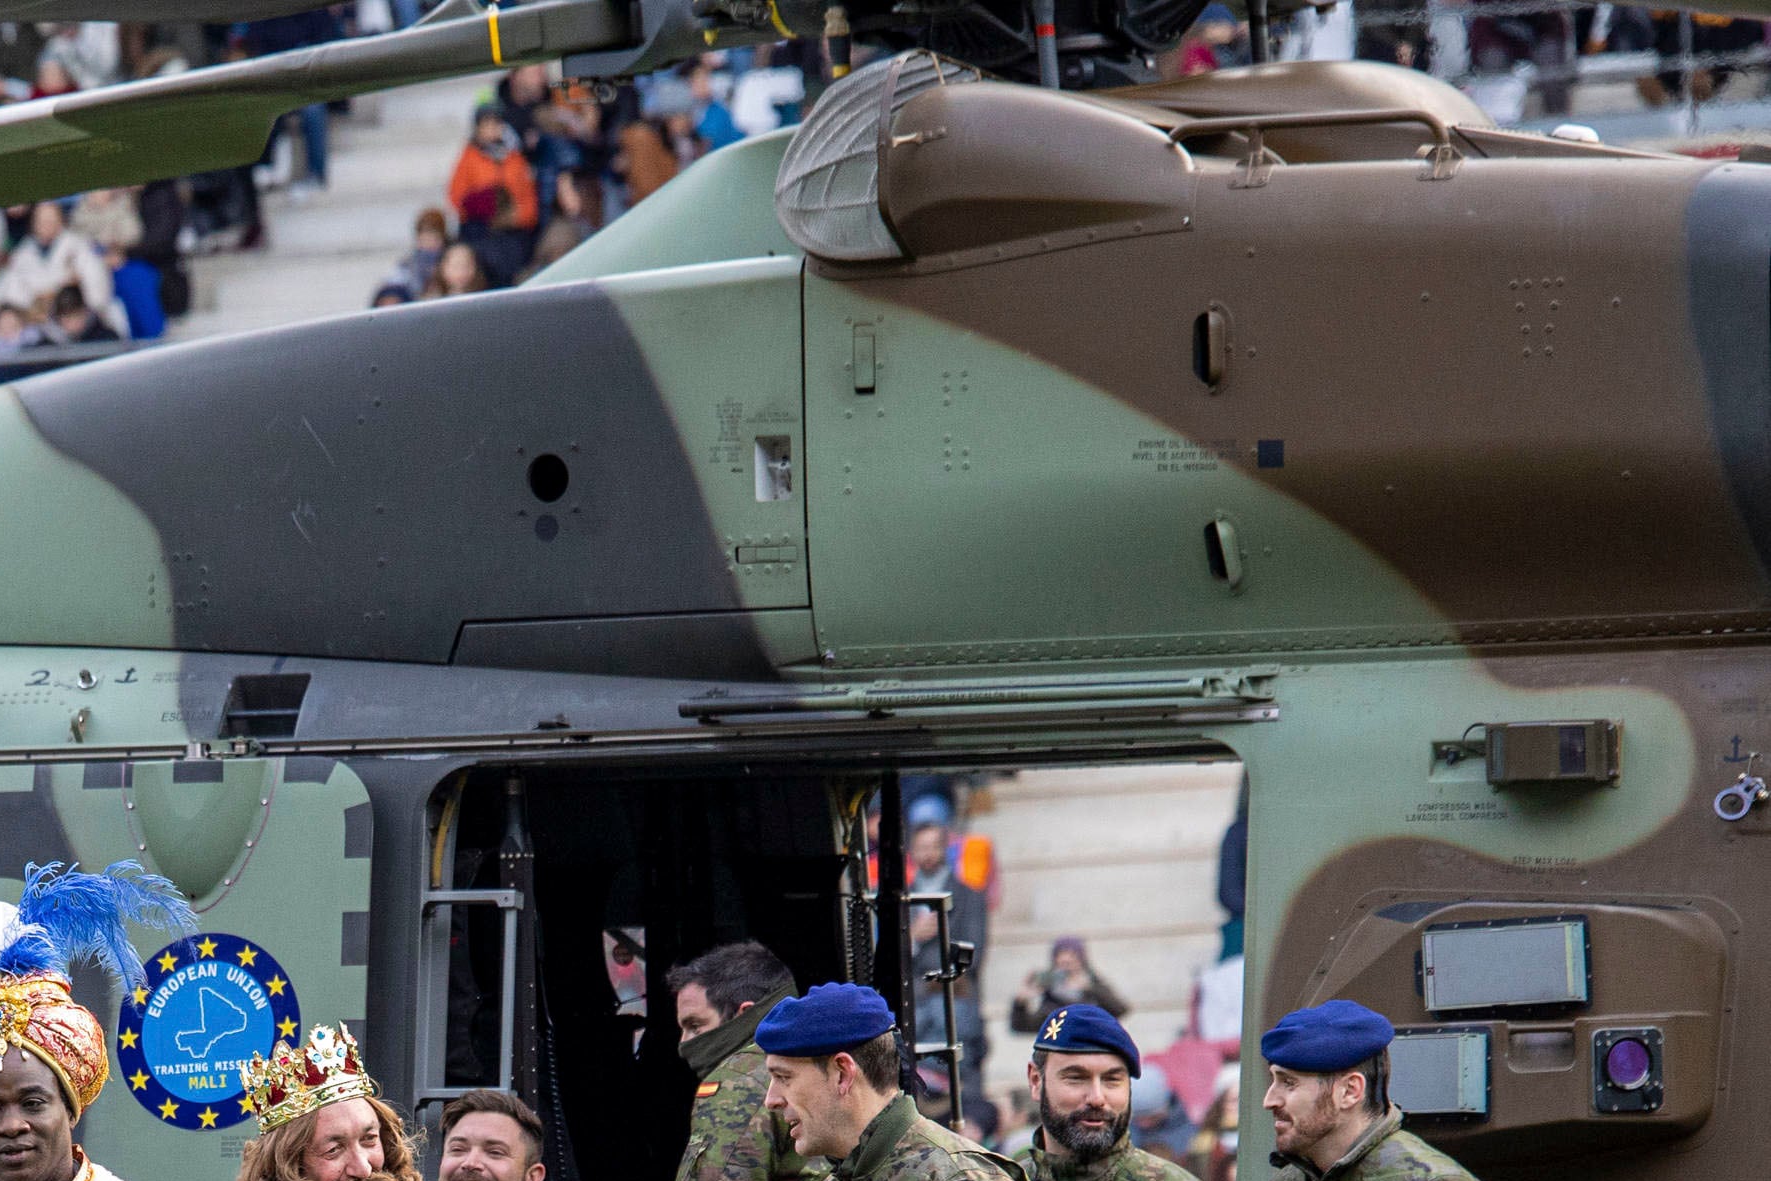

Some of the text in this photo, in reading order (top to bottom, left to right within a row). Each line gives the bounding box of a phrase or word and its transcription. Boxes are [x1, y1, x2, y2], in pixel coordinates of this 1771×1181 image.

[148, 964, 268, 1019] EUROPEAN UNION
[154, 1063, 209, 1076] TRAINING
[189, 1073, 227, 1090] MALI
